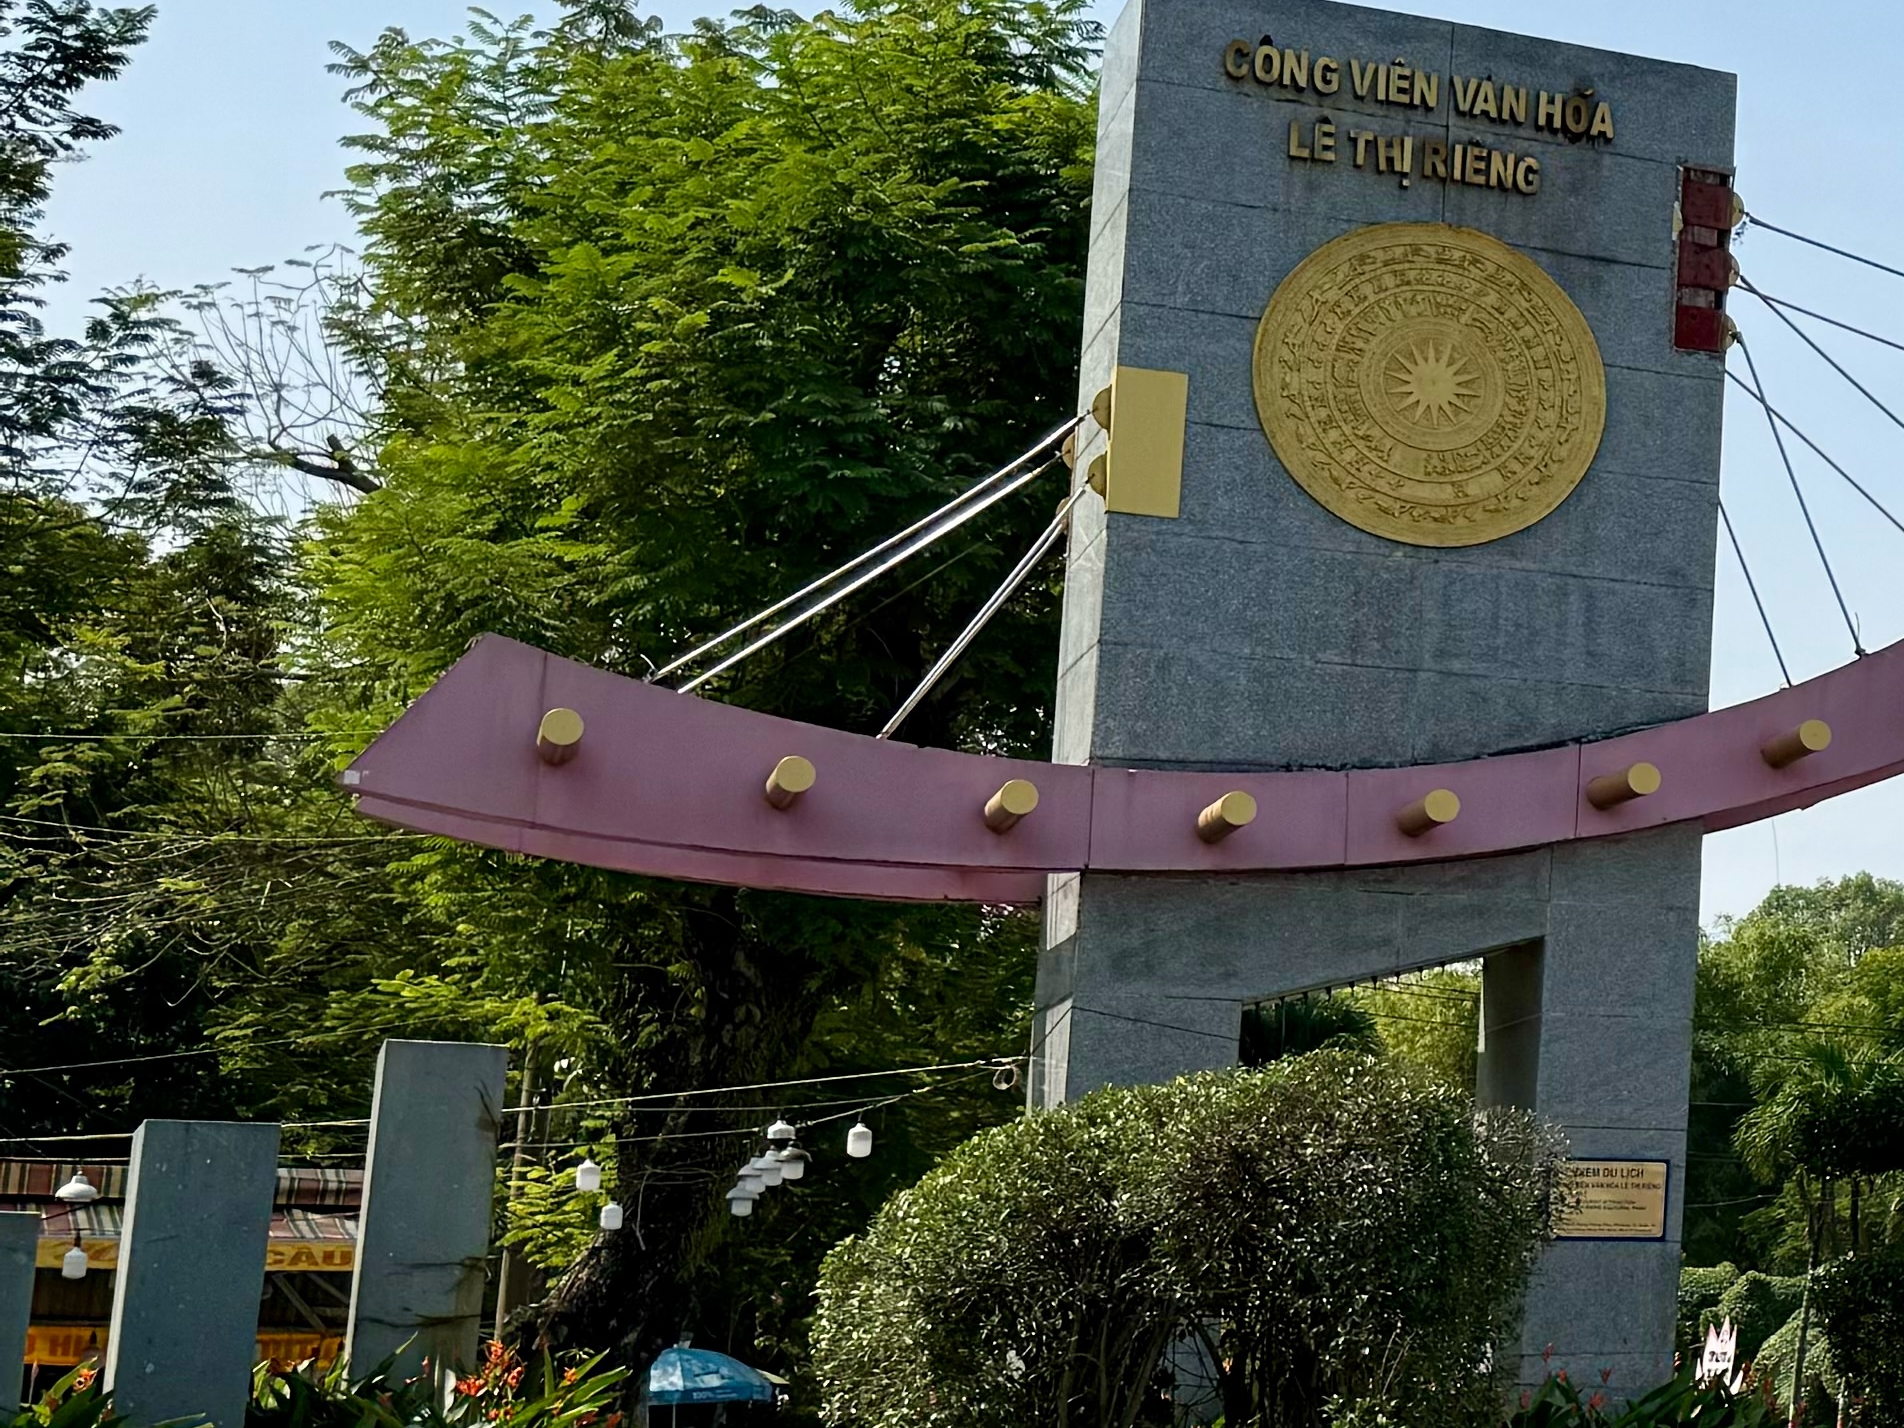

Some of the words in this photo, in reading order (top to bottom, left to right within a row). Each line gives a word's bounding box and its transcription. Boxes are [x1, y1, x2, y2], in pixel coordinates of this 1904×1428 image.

[1224, 34, 1340, 95] CÔNG
[1350, 57, 1439, 109] VIÊN
[1537, 87, 1615, 141] HÓA
[1288, 116, 1337, 162] LÊ
[1349, 129, 1413, 187] THỊ
[1423, 138, 1541, 195] RIÊNG
